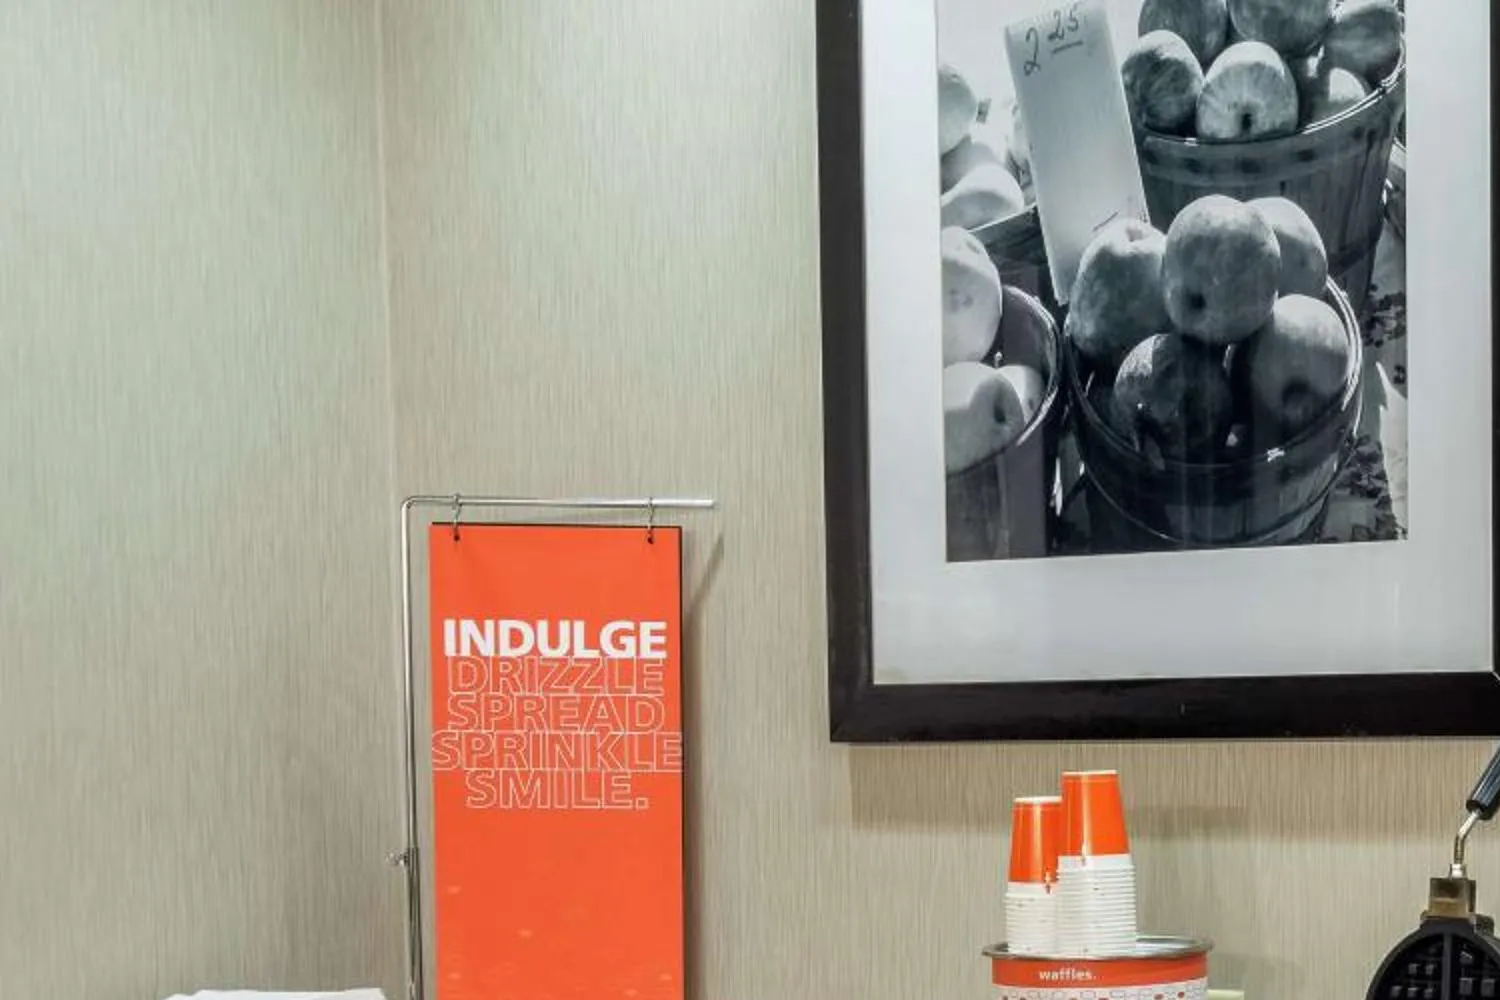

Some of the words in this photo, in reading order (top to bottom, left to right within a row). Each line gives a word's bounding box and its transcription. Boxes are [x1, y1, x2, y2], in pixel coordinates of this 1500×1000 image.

[444, 619, 667, 659] INDULGE
[448, 655, 664, 696] DRIZZLE
[448, 693, 664, 733] SPREAD
[432, 730, 683, 772] SPRINKLE
[466, 768, 648, 809] SMILE.
